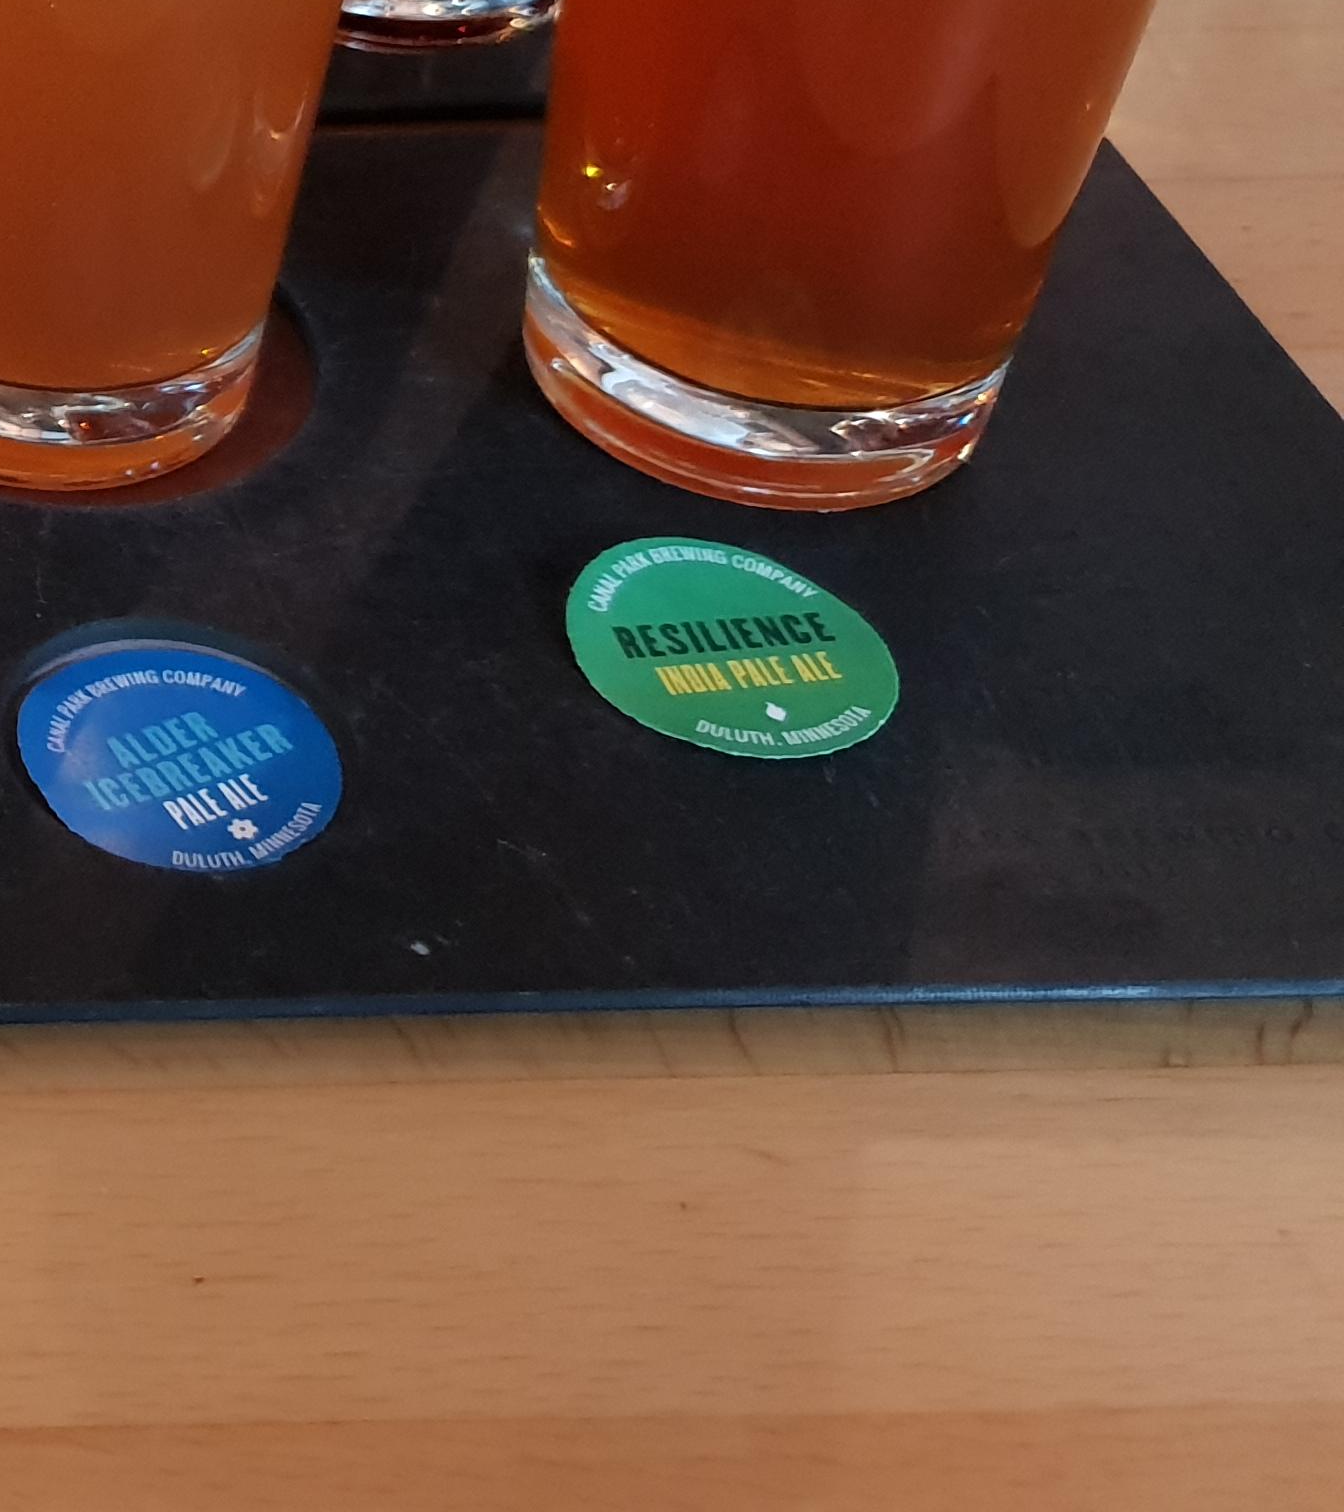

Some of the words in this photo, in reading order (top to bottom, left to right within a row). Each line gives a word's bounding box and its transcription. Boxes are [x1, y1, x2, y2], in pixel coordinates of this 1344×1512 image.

[587, 570, 624, 613] CANAL
[616, 552, 652, 580] PARK
[648, 545, 728, 566] BREWING
[731, 554, 819, 600] COMPANY
[612, 612, 837, 660] RESILIENCE
[85, 669, 159, 698] BREWING
[162, 669, 247, 697] COMPANY
[654, 662, 733, 696] INDIA
[726, 656, 795, 688] PALE
[790, 651, 843, 683] ALE
[56, 688, 90, 719] PARK
[781, 704, 872, 745] MINNESOTA
[47, 716, 71, 753] CANAL
[106, 711, 218, 770] ALDER
[82, 723, 294, 812] ICEBREAKER
[163, 788, 228, 831] PALE
[216, 773, 269, 812] ALE
[248, 801, 323, 861] MINNESOTA
